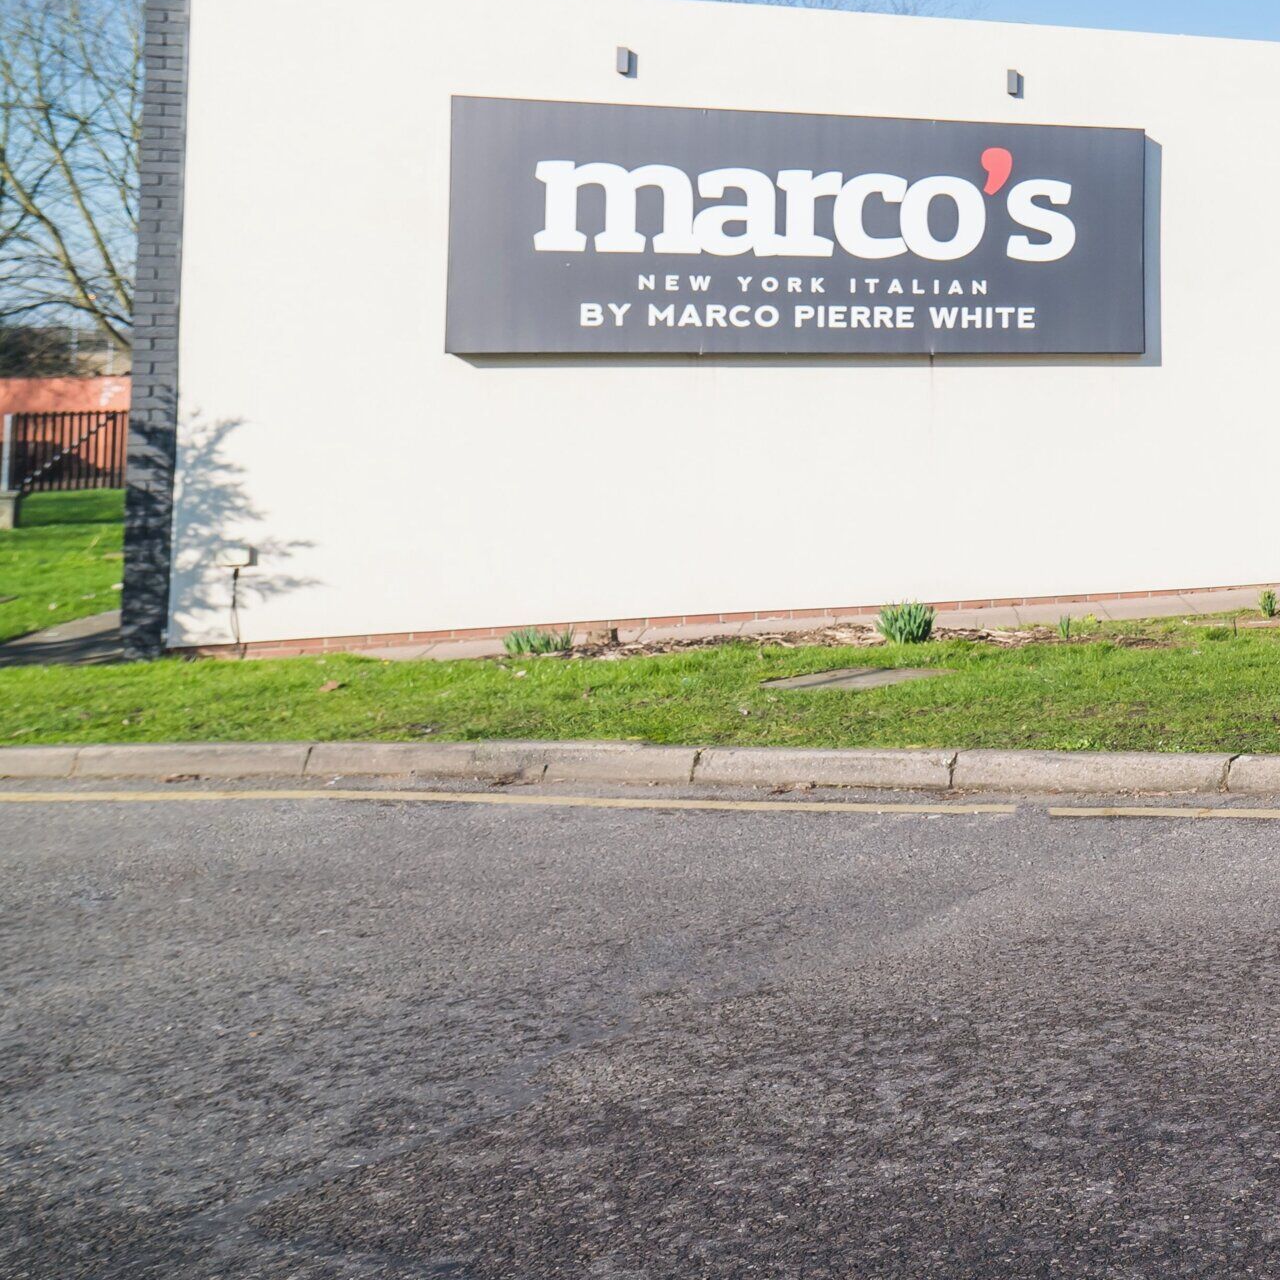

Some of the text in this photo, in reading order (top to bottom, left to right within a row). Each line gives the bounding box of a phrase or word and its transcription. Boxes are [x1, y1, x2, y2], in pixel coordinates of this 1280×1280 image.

[533, 147, 1076, 262] marco's
[638, 274, 988, 296] NEW YORK ITALIAN
[580, 302, 1036, 329] BY MARCO PIERRE WHITE
